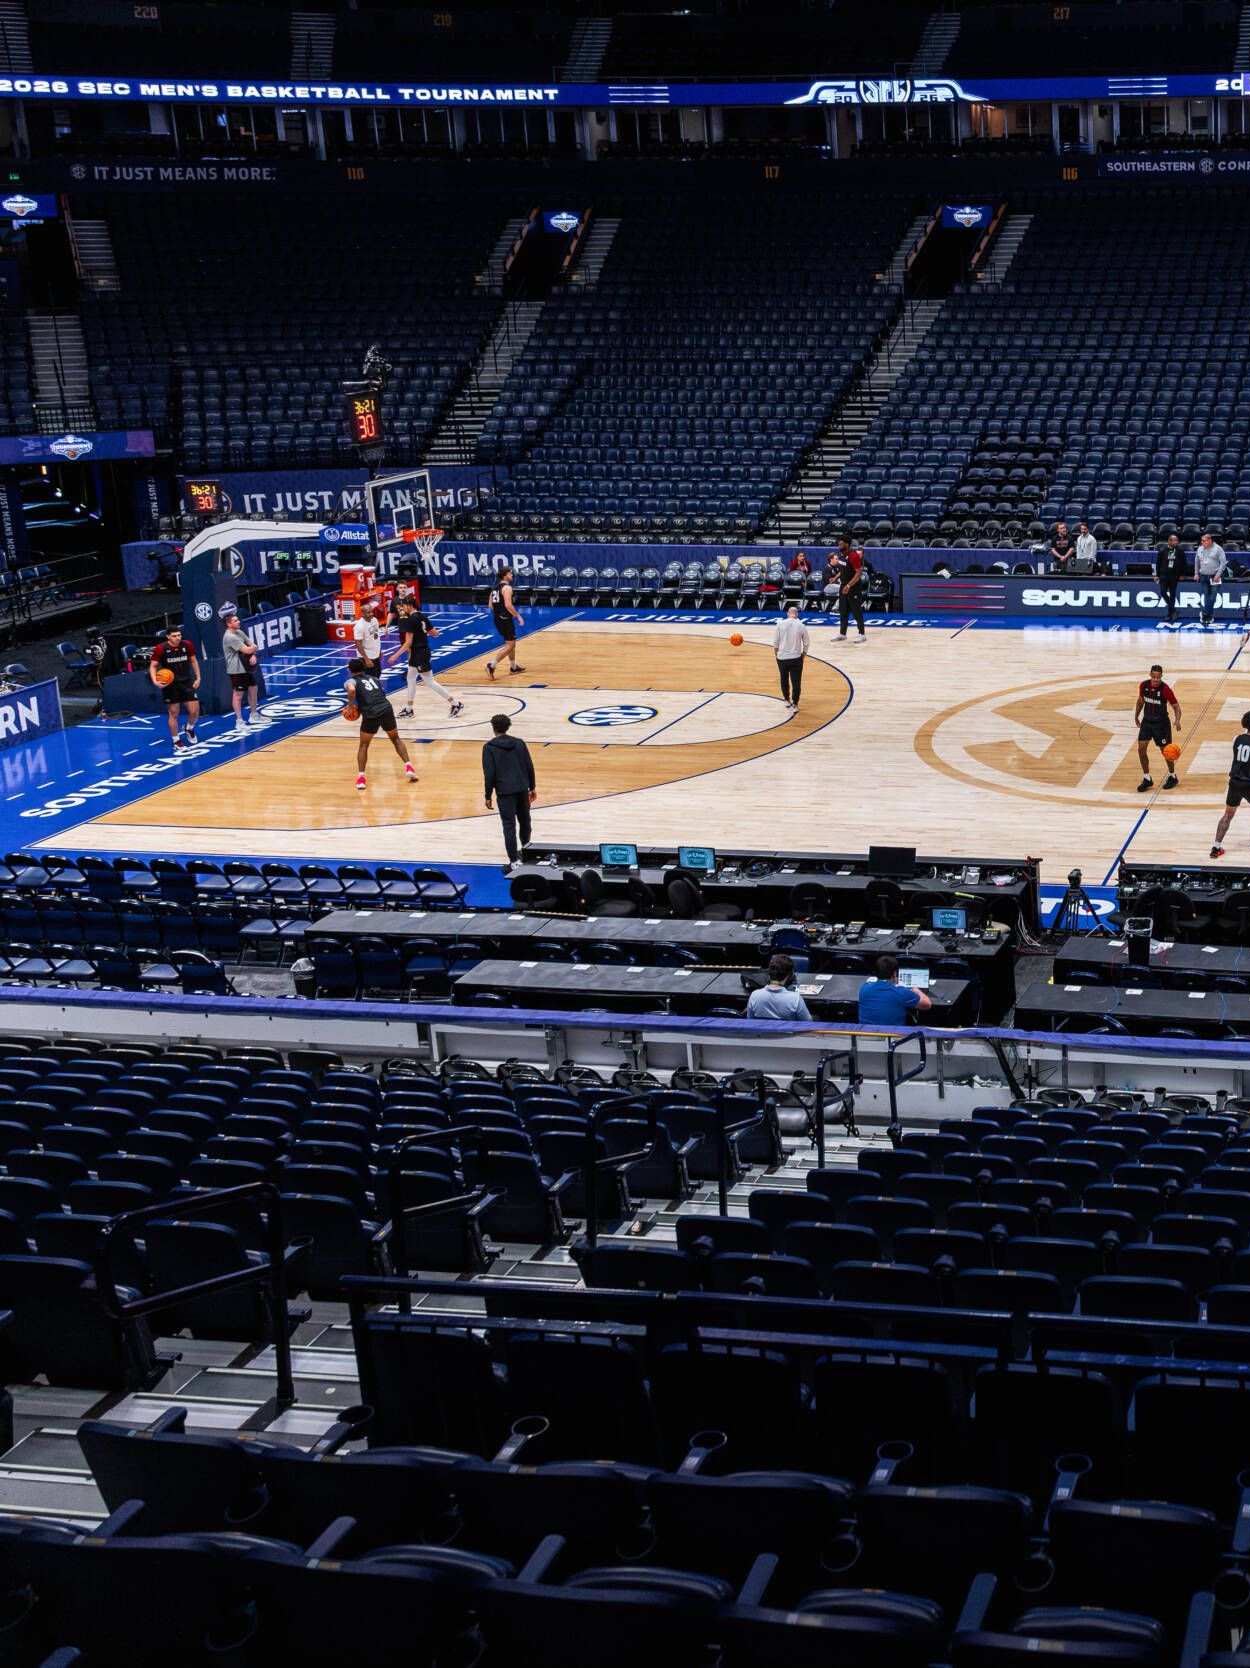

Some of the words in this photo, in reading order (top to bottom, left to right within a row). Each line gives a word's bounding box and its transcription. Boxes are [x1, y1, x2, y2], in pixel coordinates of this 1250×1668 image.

[134, 6, 158, 19] 220
[0, 80, 68, 93] 2026
[78, 82, 131, 95] SEC
[139, 83, 218, 97] MEN'S
[227, 86, 391, 100] BASKETBALL
[398, 88, 559, 101] TOURNAMENT
[763, 165, 779, 179] 117
[1106, 160, 1196, 172] SOUTHEASTERN
[94, 166, 112, 180] IT
[114, 166, 154, 181] JUST
[160, 167, 218, 181] MEANS
[354, 400, 374, 414] 36:21
[358, 414, 375, 438] 30
[191, 485, 217, 495] 36:21
[199, 496, 214, 509] 30
[243, 494, 267, 513] IT
[272, 491, 333, 512] JUST
[341, 530, 370, 540] Allstat
[1022, 589, 1130, 608] SOUTH
[605, 613, 638, 621] IT
[640, 614, 715, 622] JUST
[335, 628, 347, 638] G
[364, 679, 380, 692] 31
[1236, 745, 1250, 763] 10
